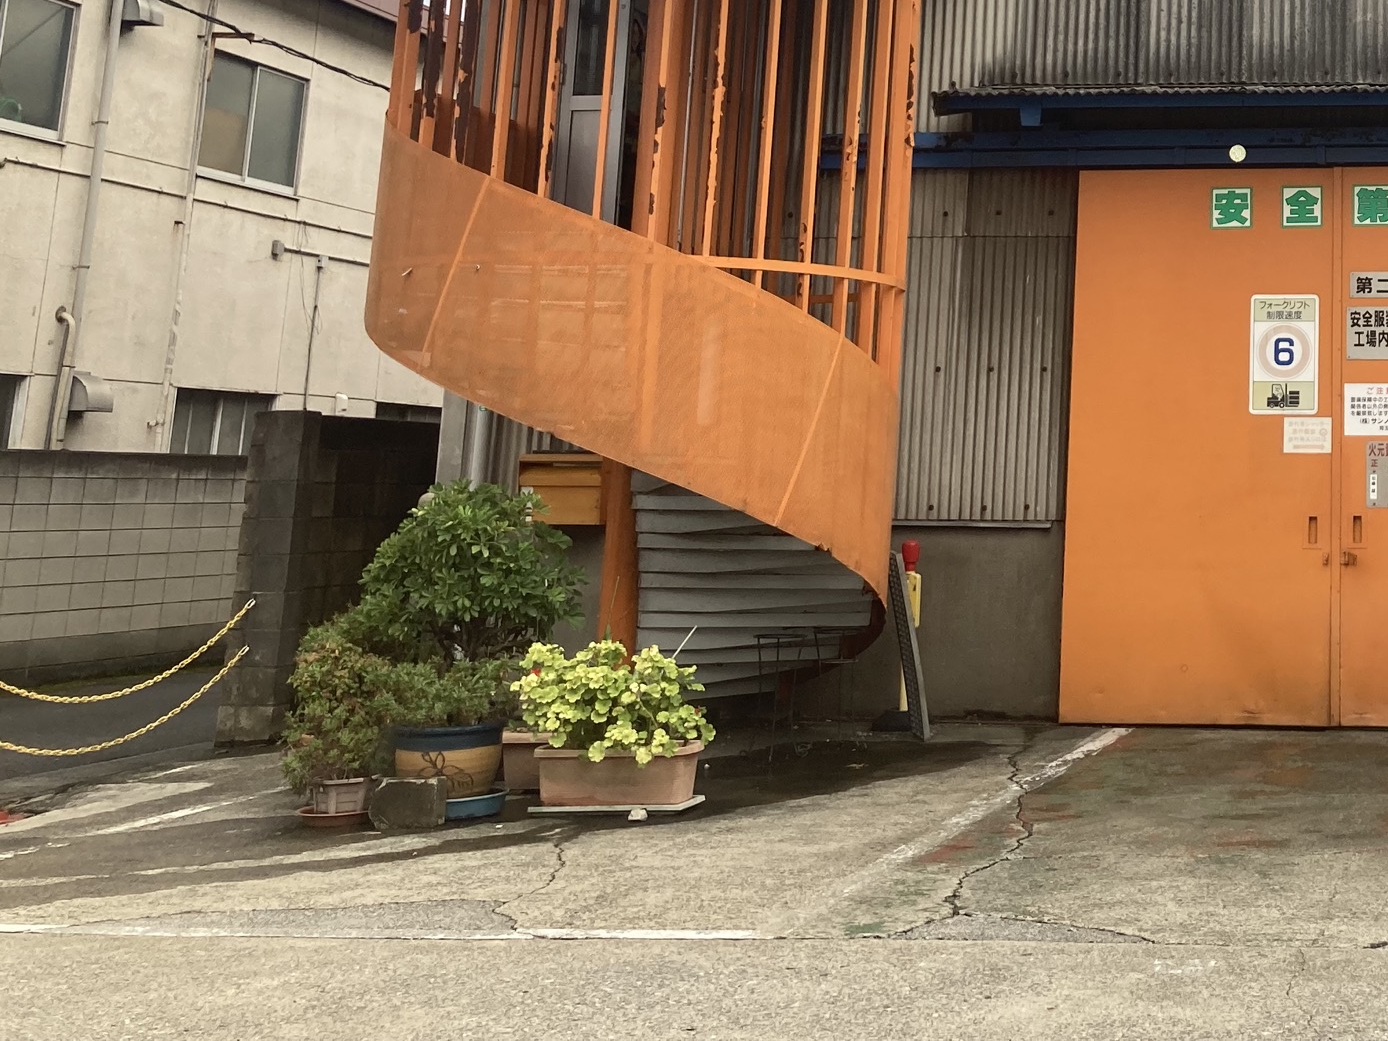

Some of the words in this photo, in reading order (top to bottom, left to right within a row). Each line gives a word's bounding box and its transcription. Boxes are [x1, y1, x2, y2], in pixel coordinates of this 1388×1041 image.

[1259, 301, 1310, 310] フォークリフト
[1267, 310, 1302, 320] 制限速度
[1274, 337, 1294, 366] 6
